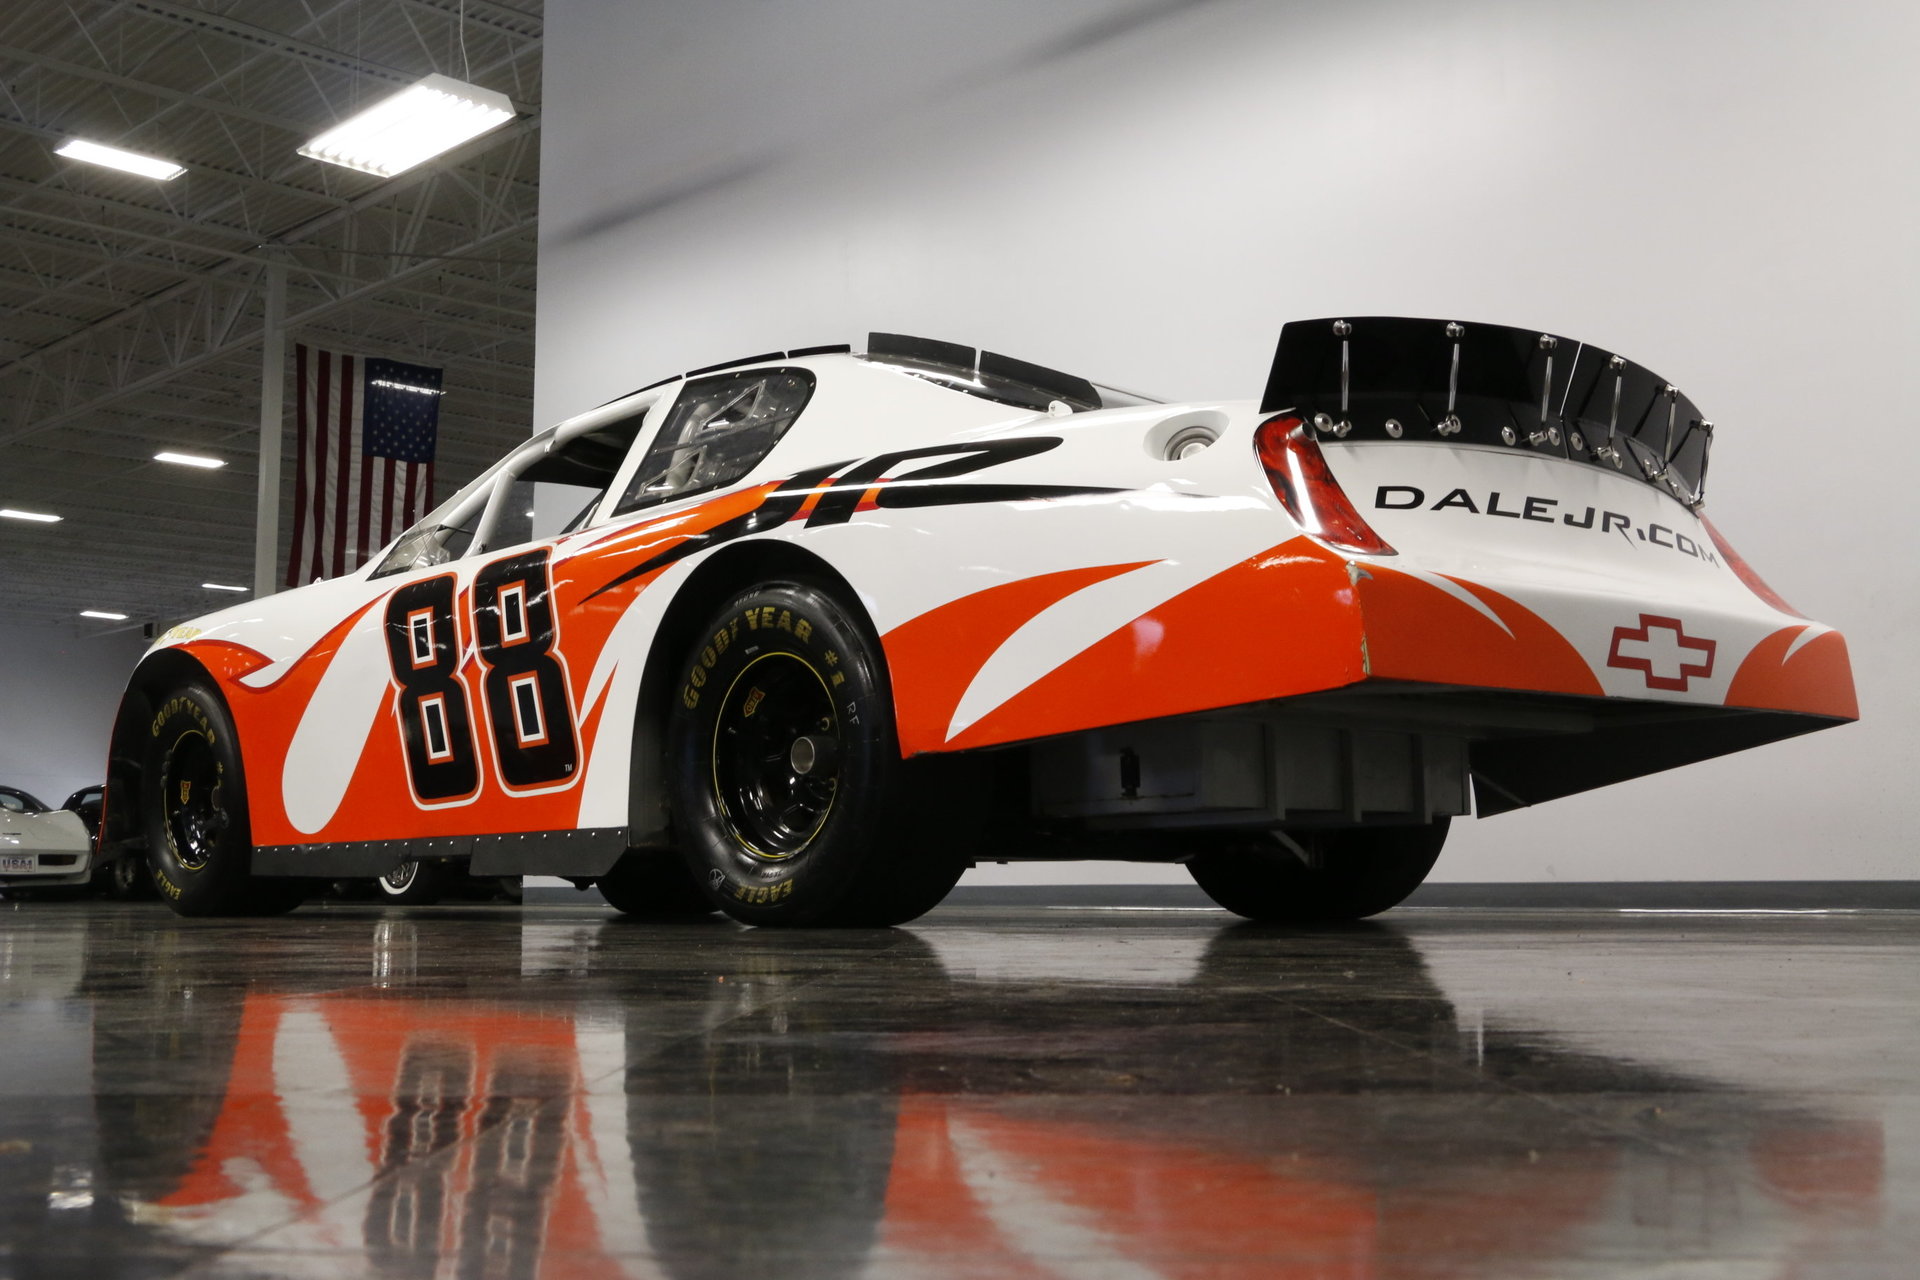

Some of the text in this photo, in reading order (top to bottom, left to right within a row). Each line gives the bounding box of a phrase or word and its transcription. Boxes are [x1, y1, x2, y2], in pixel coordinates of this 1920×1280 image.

[1374, 485, 1720, 569] DALEJR.COM
[384, 545, 584, 810] 88
[564, 763, 573, 772] TM
[155, 869, 183, 901] EAGLE
[734, 878, 794, 904] EAGLE
